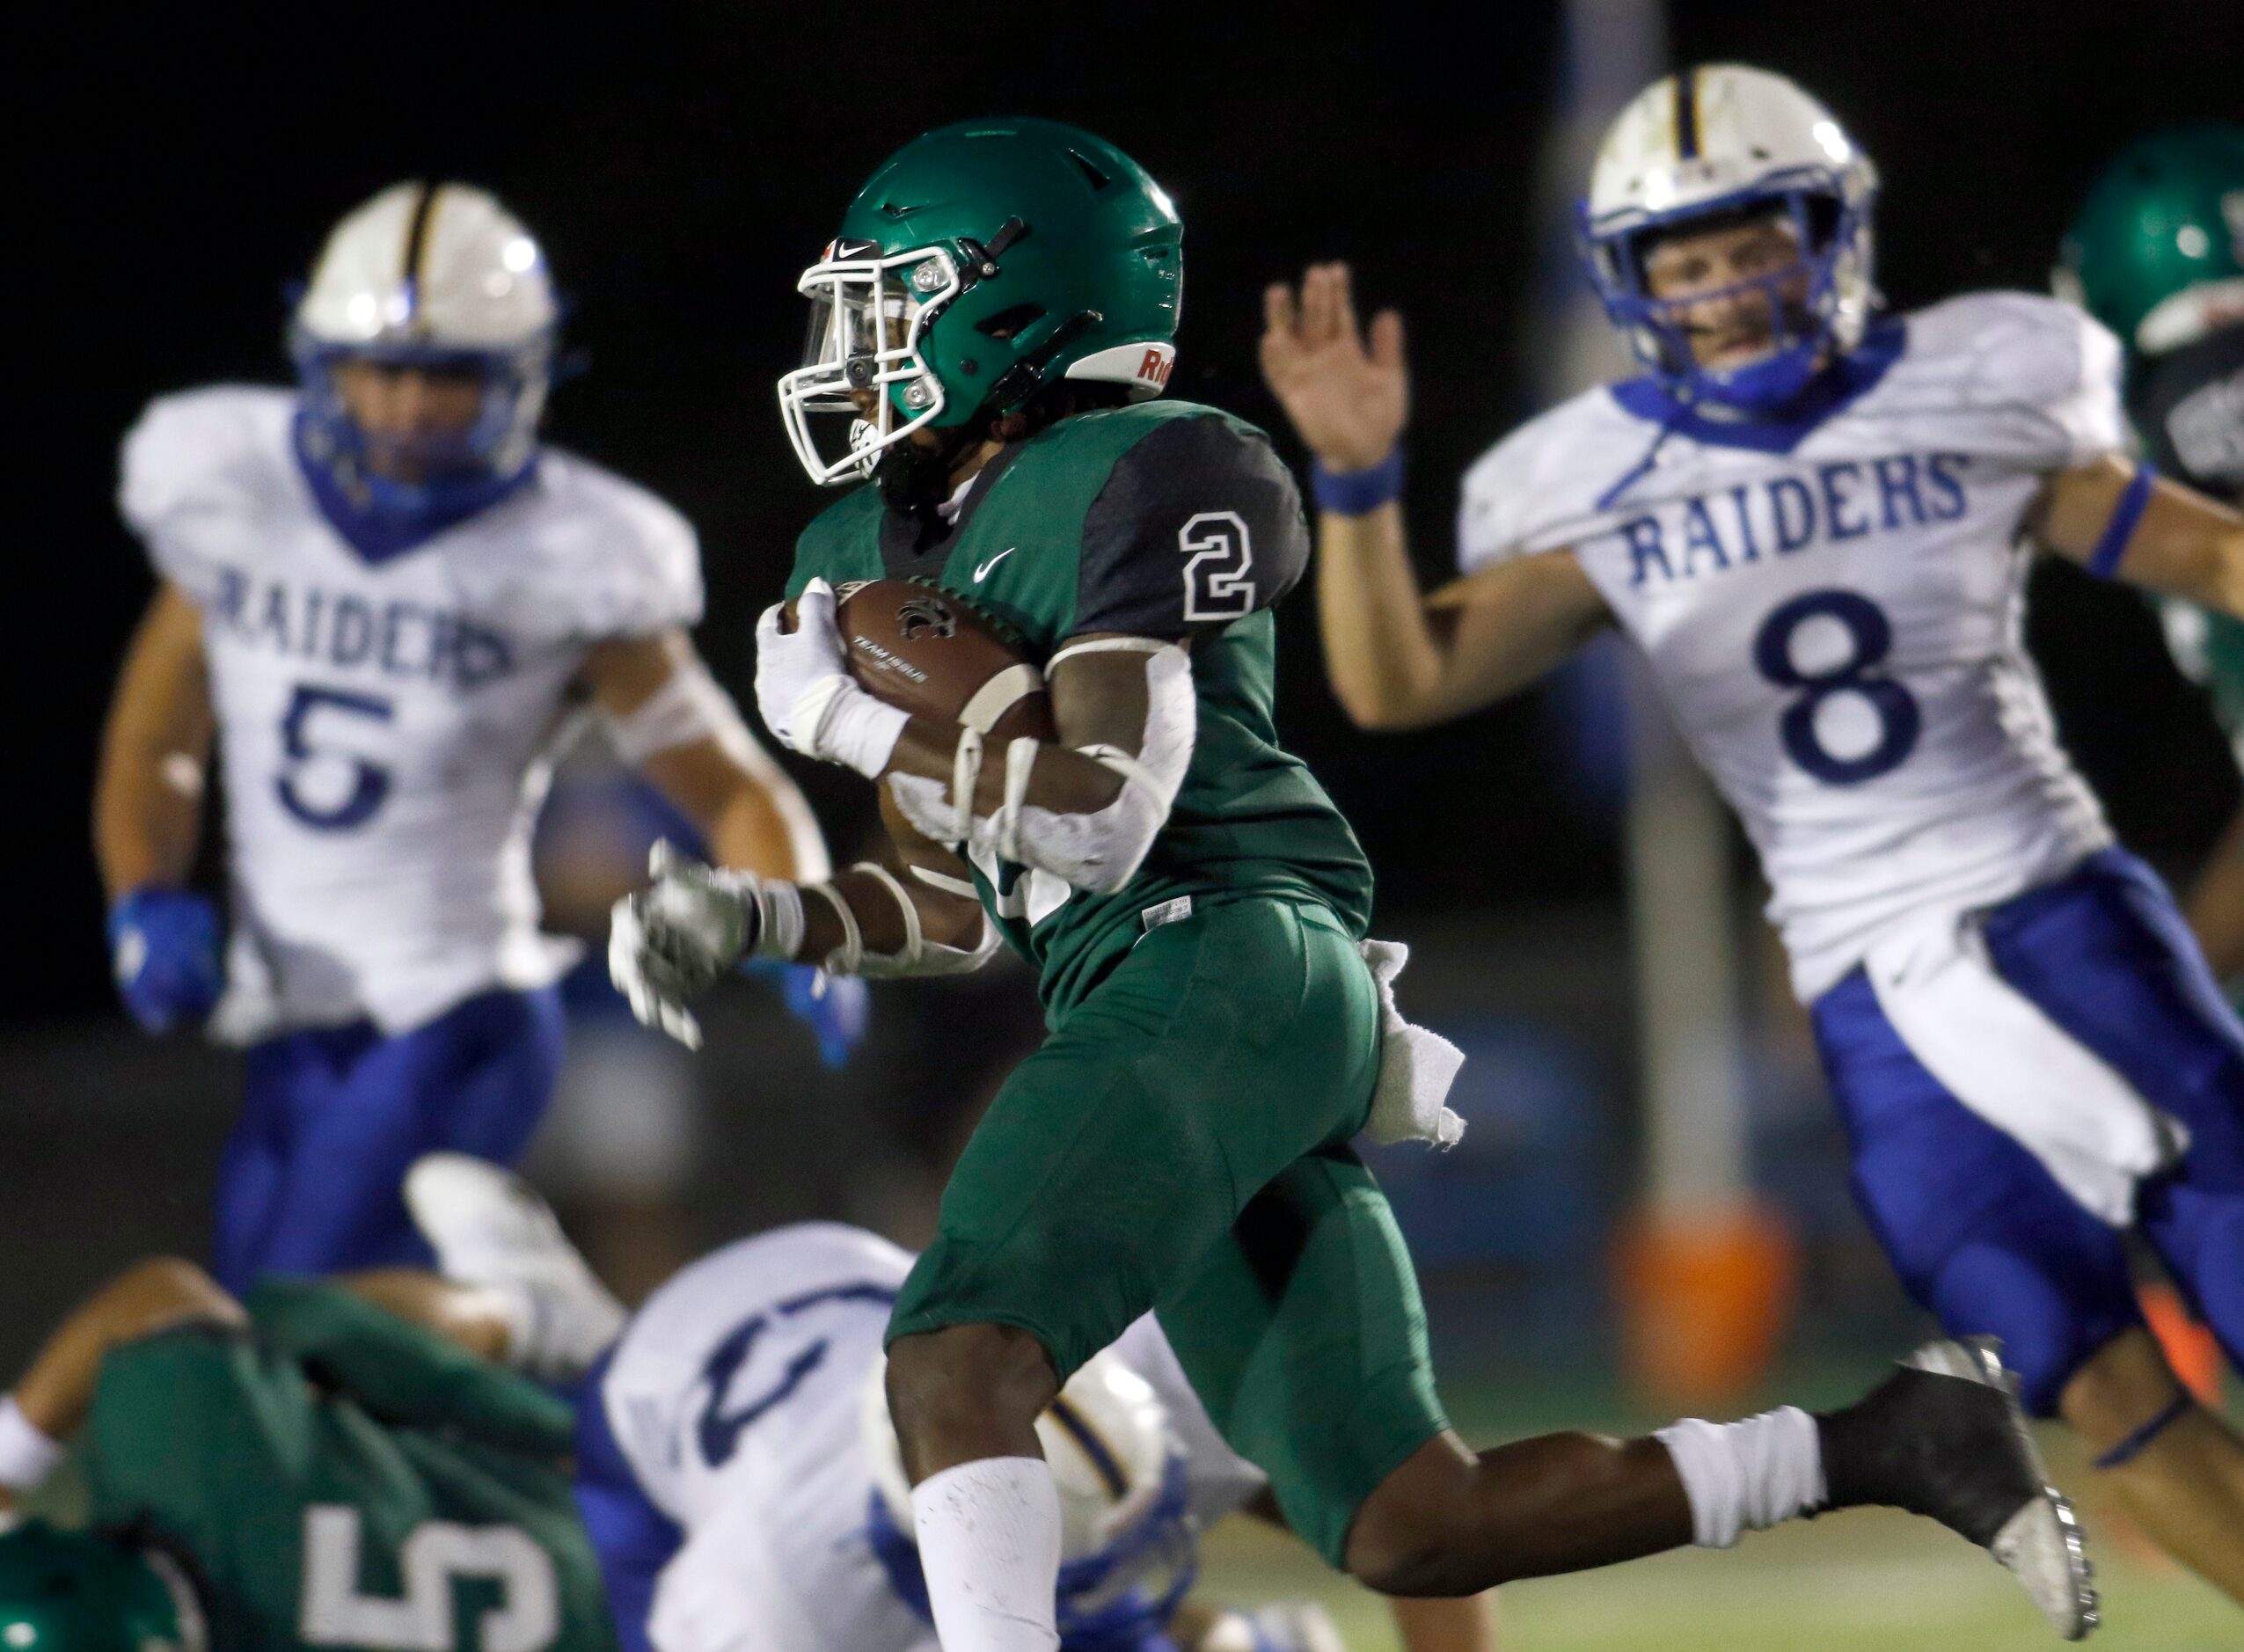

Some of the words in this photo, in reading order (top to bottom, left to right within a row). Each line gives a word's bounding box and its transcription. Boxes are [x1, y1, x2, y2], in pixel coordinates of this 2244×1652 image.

[1178, 510, 1255, 621] 2
[1620, 454, 1969, 584] RAIDERS
[274, 681, 396, 832] 5
[1756, 589, 1919, 784] 8
